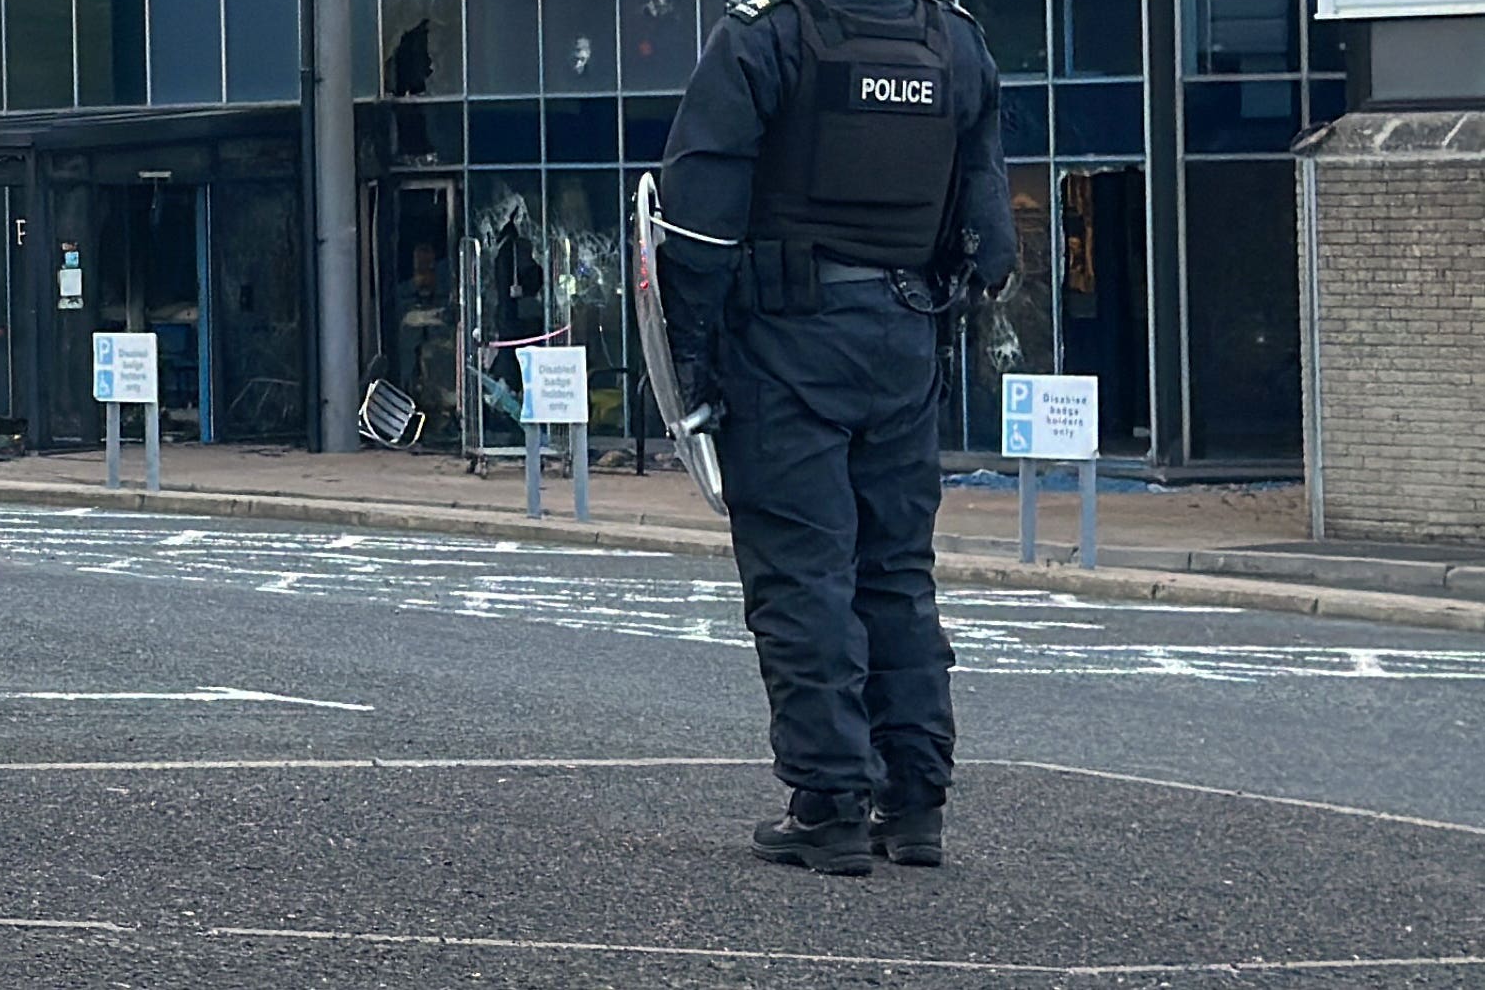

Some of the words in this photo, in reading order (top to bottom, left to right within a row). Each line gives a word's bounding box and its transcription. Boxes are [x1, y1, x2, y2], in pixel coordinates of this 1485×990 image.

[861, 77, 933, 104] POLICE
[538, 365, 577, 374] Disabled
[544, 377, 571, 388] badge
[1011, 383, 1028, 411] P
[1043, 393, 1087, 405] Disabled
[1049, 406, 1079, 416] badge
[1046, 416, 1083, 427] holders
[1053, 429, 1074, 439] only
